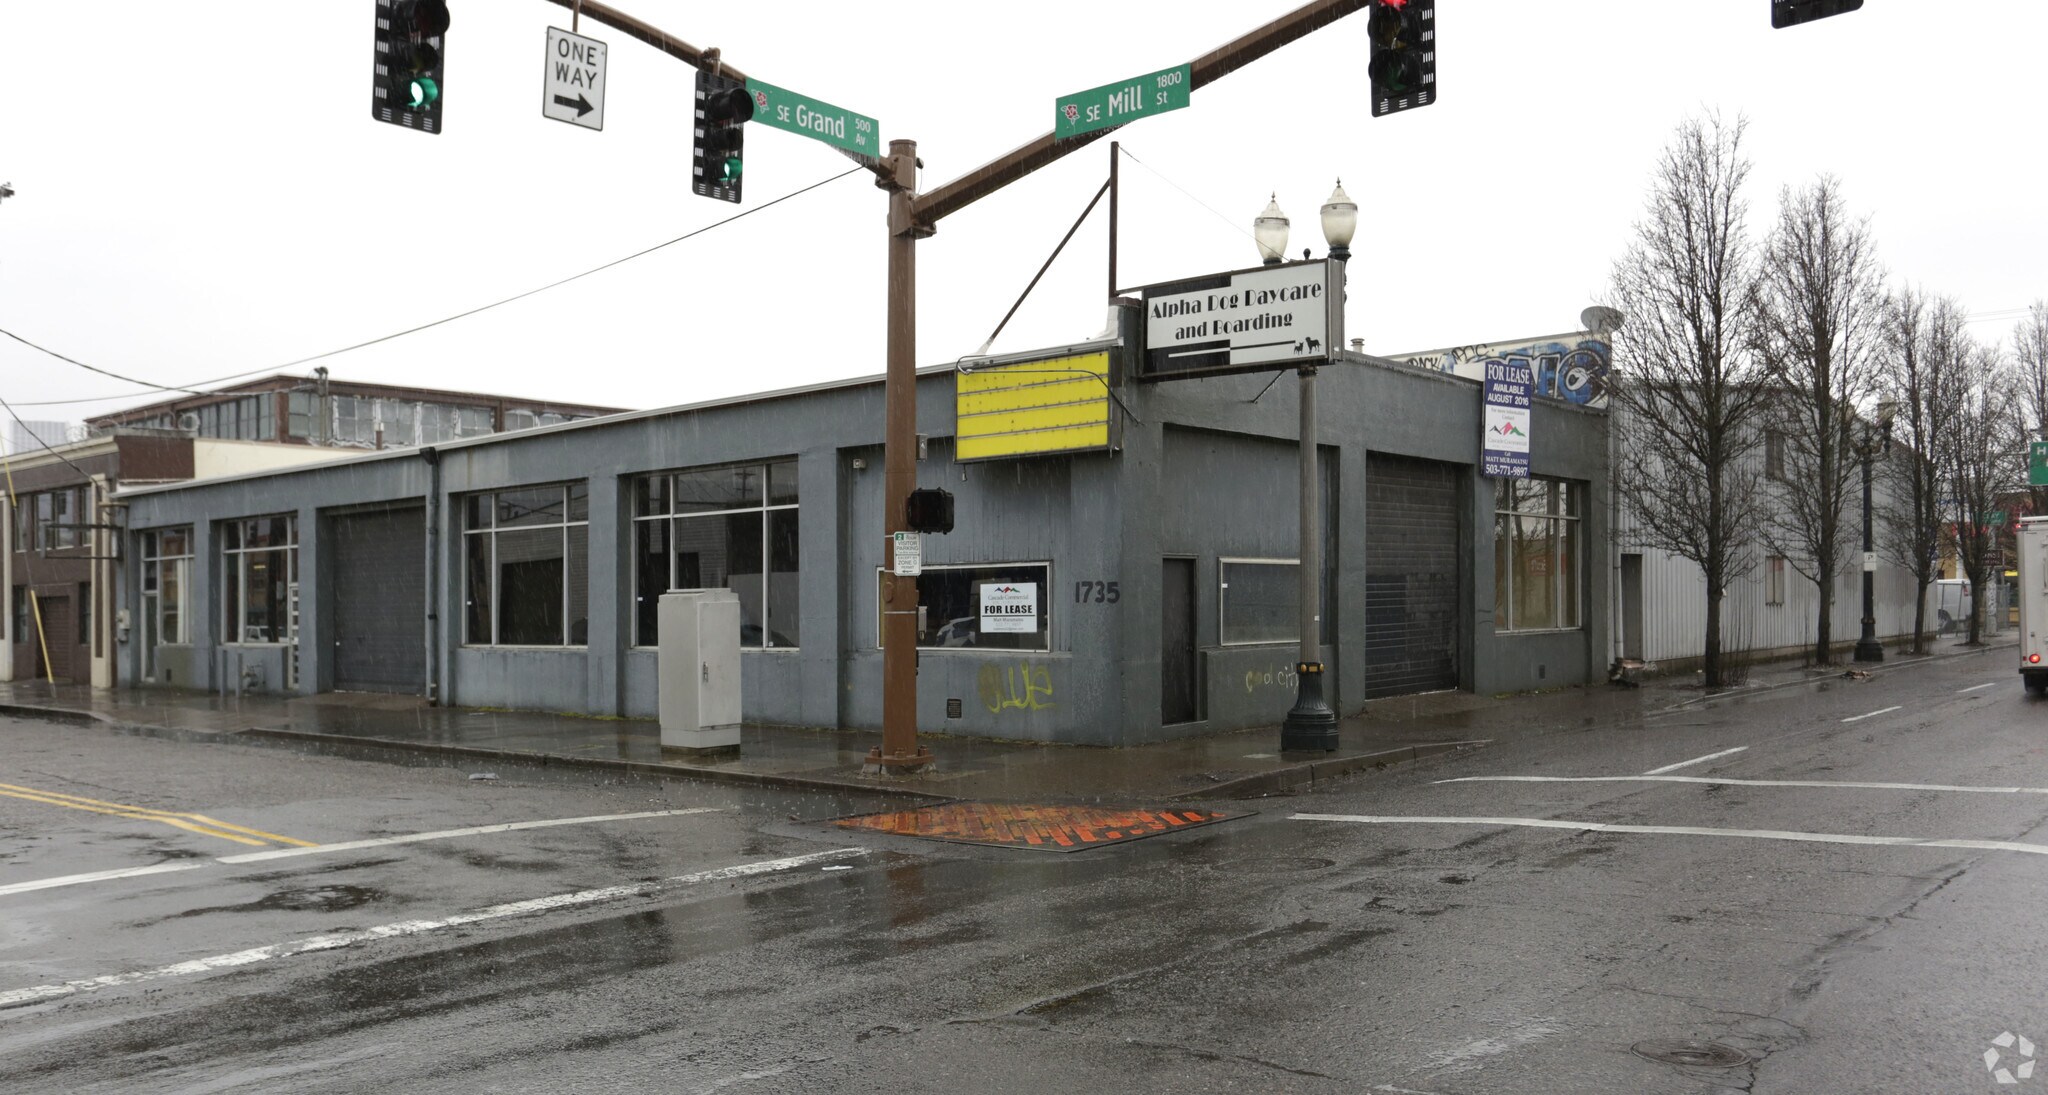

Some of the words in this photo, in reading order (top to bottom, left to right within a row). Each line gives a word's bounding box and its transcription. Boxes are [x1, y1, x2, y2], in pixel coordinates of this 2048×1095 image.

[557, 38, 598, 67] ONE
[555, 62, 598, 91] WAY
[1156, 71, 1182, 89] 1800
[1086, 105, 1101, 123] SE
[1108, 85, 1143, 117] Mill
[1156, 91, 1168, 106] St
[777, 104, 791, 124] SE
[796, 104, 846, 140] Grand
[855, 118, 872, 135] 500
[855, 132, 867, 146] Av
[1150, 294, 1202, 320] Alpha
[1207, 293, 1239, 314] Dog
[1245, 282, 1322, 306] Daycare
[1175, 320, 1207, 341] and
[1213, 312, 1293, 336] Boarding
[1487, 364, 1504, 381] FOR
[1506, 367, 1530, 385] LEASE
[1493, 383, 1525, 395] AVAILABLE
[1488, 393, 1513, 404] AUGUST
[1514, 396, 1529, 406] 2016
[1500, 457, 1528, 465] MURAMATSU
[1486, 464, 1528, 477] 503-771-9897
[1074, 581, 1121, 604] 1735
[984, 605, 1003, 614] FOR
[1005, 605, 1033, 614] LEASE
